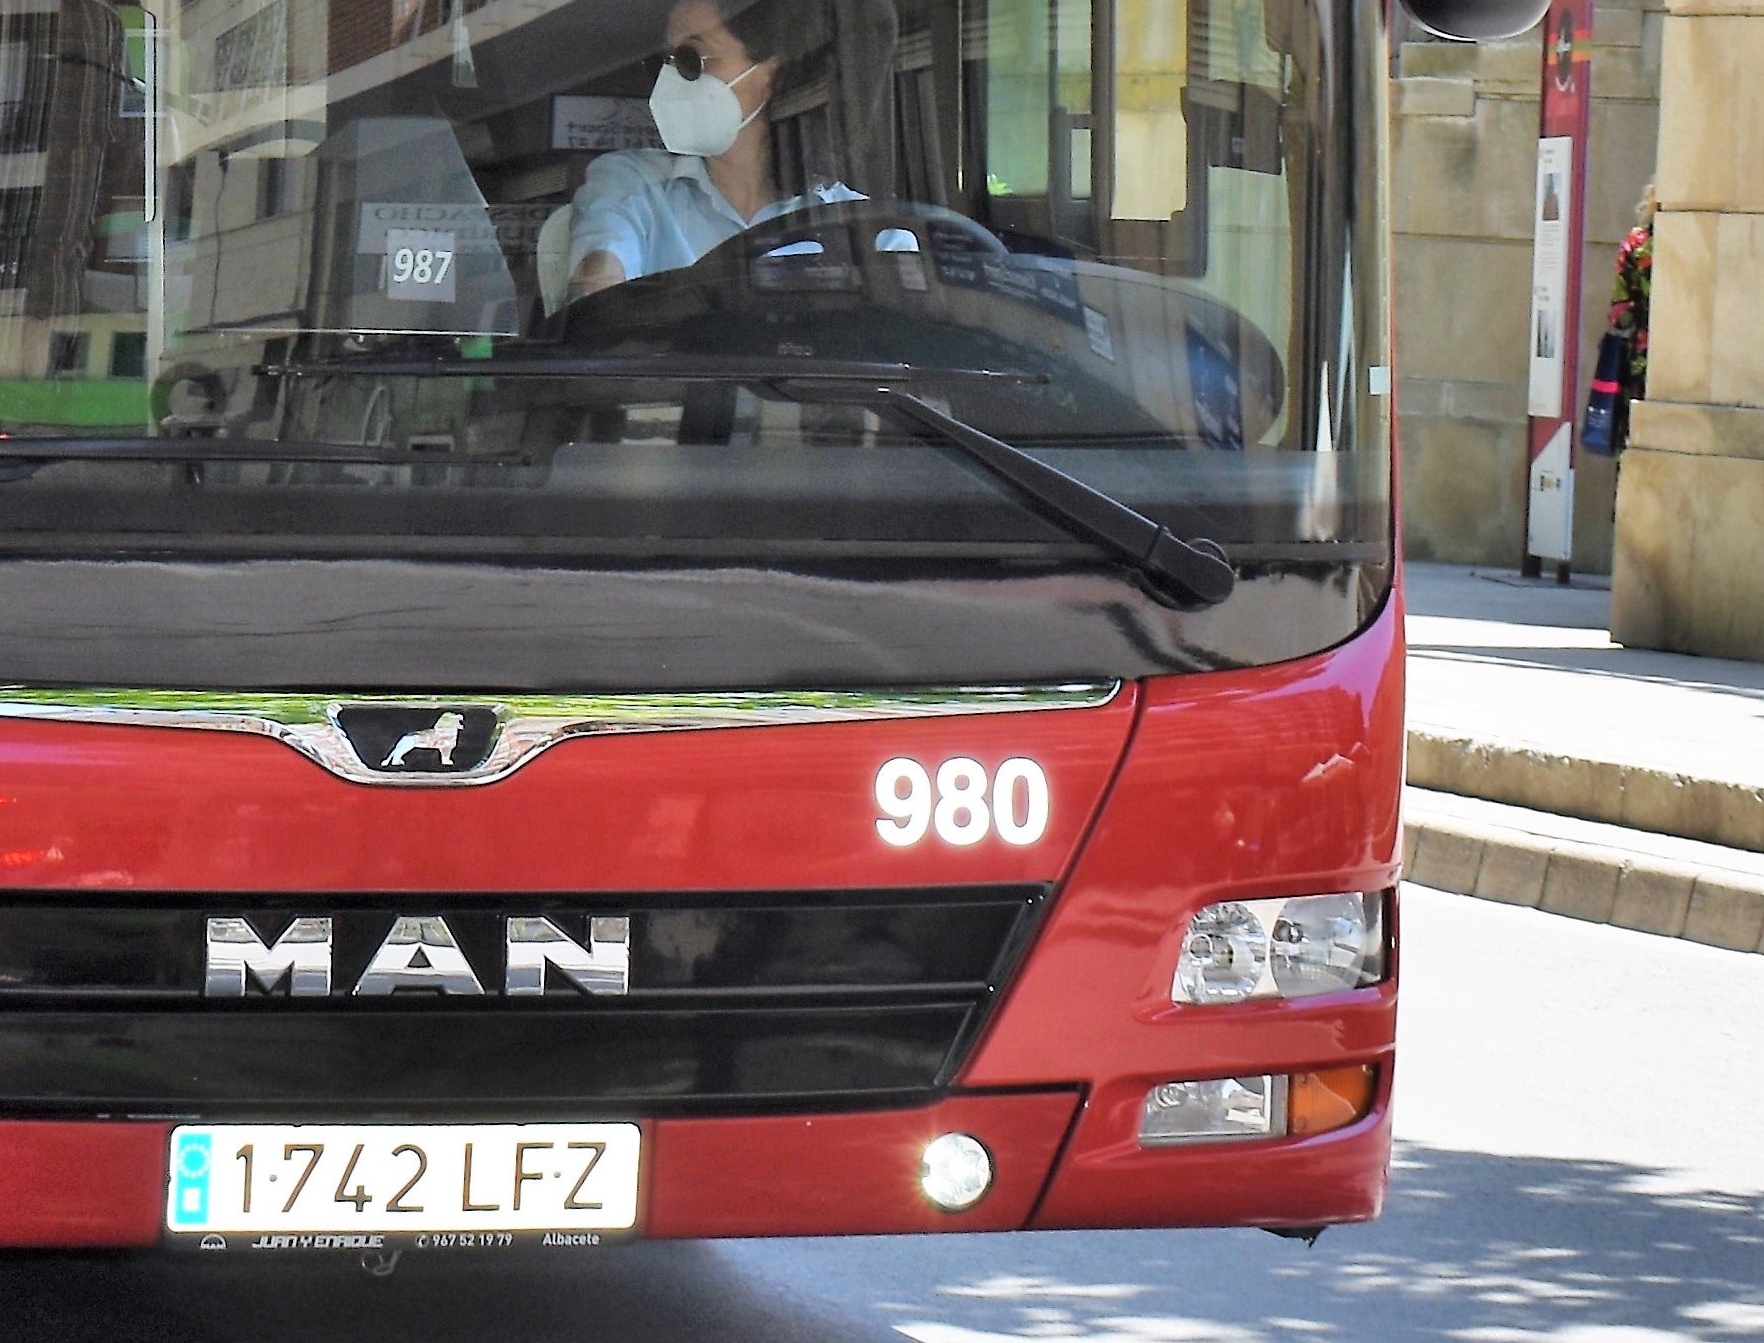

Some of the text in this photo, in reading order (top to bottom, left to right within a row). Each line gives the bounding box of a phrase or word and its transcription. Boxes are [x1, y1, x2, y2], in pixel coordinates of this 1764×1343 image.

[392, 248, 454, 285] 987
[874, 756, 1050, 847] 980
[205, 916, 631, 996] MAN
[236, 1141, 607, 1213] 1742 LFZ
[432, 1233, 456, 1247] 967
[459, 1234, 475, 1246] 52
[479, 1233, 494, 1246] 19
[497, 1233, 513, 1246] 79
[542, 1232, 601, 1247] Albacete
